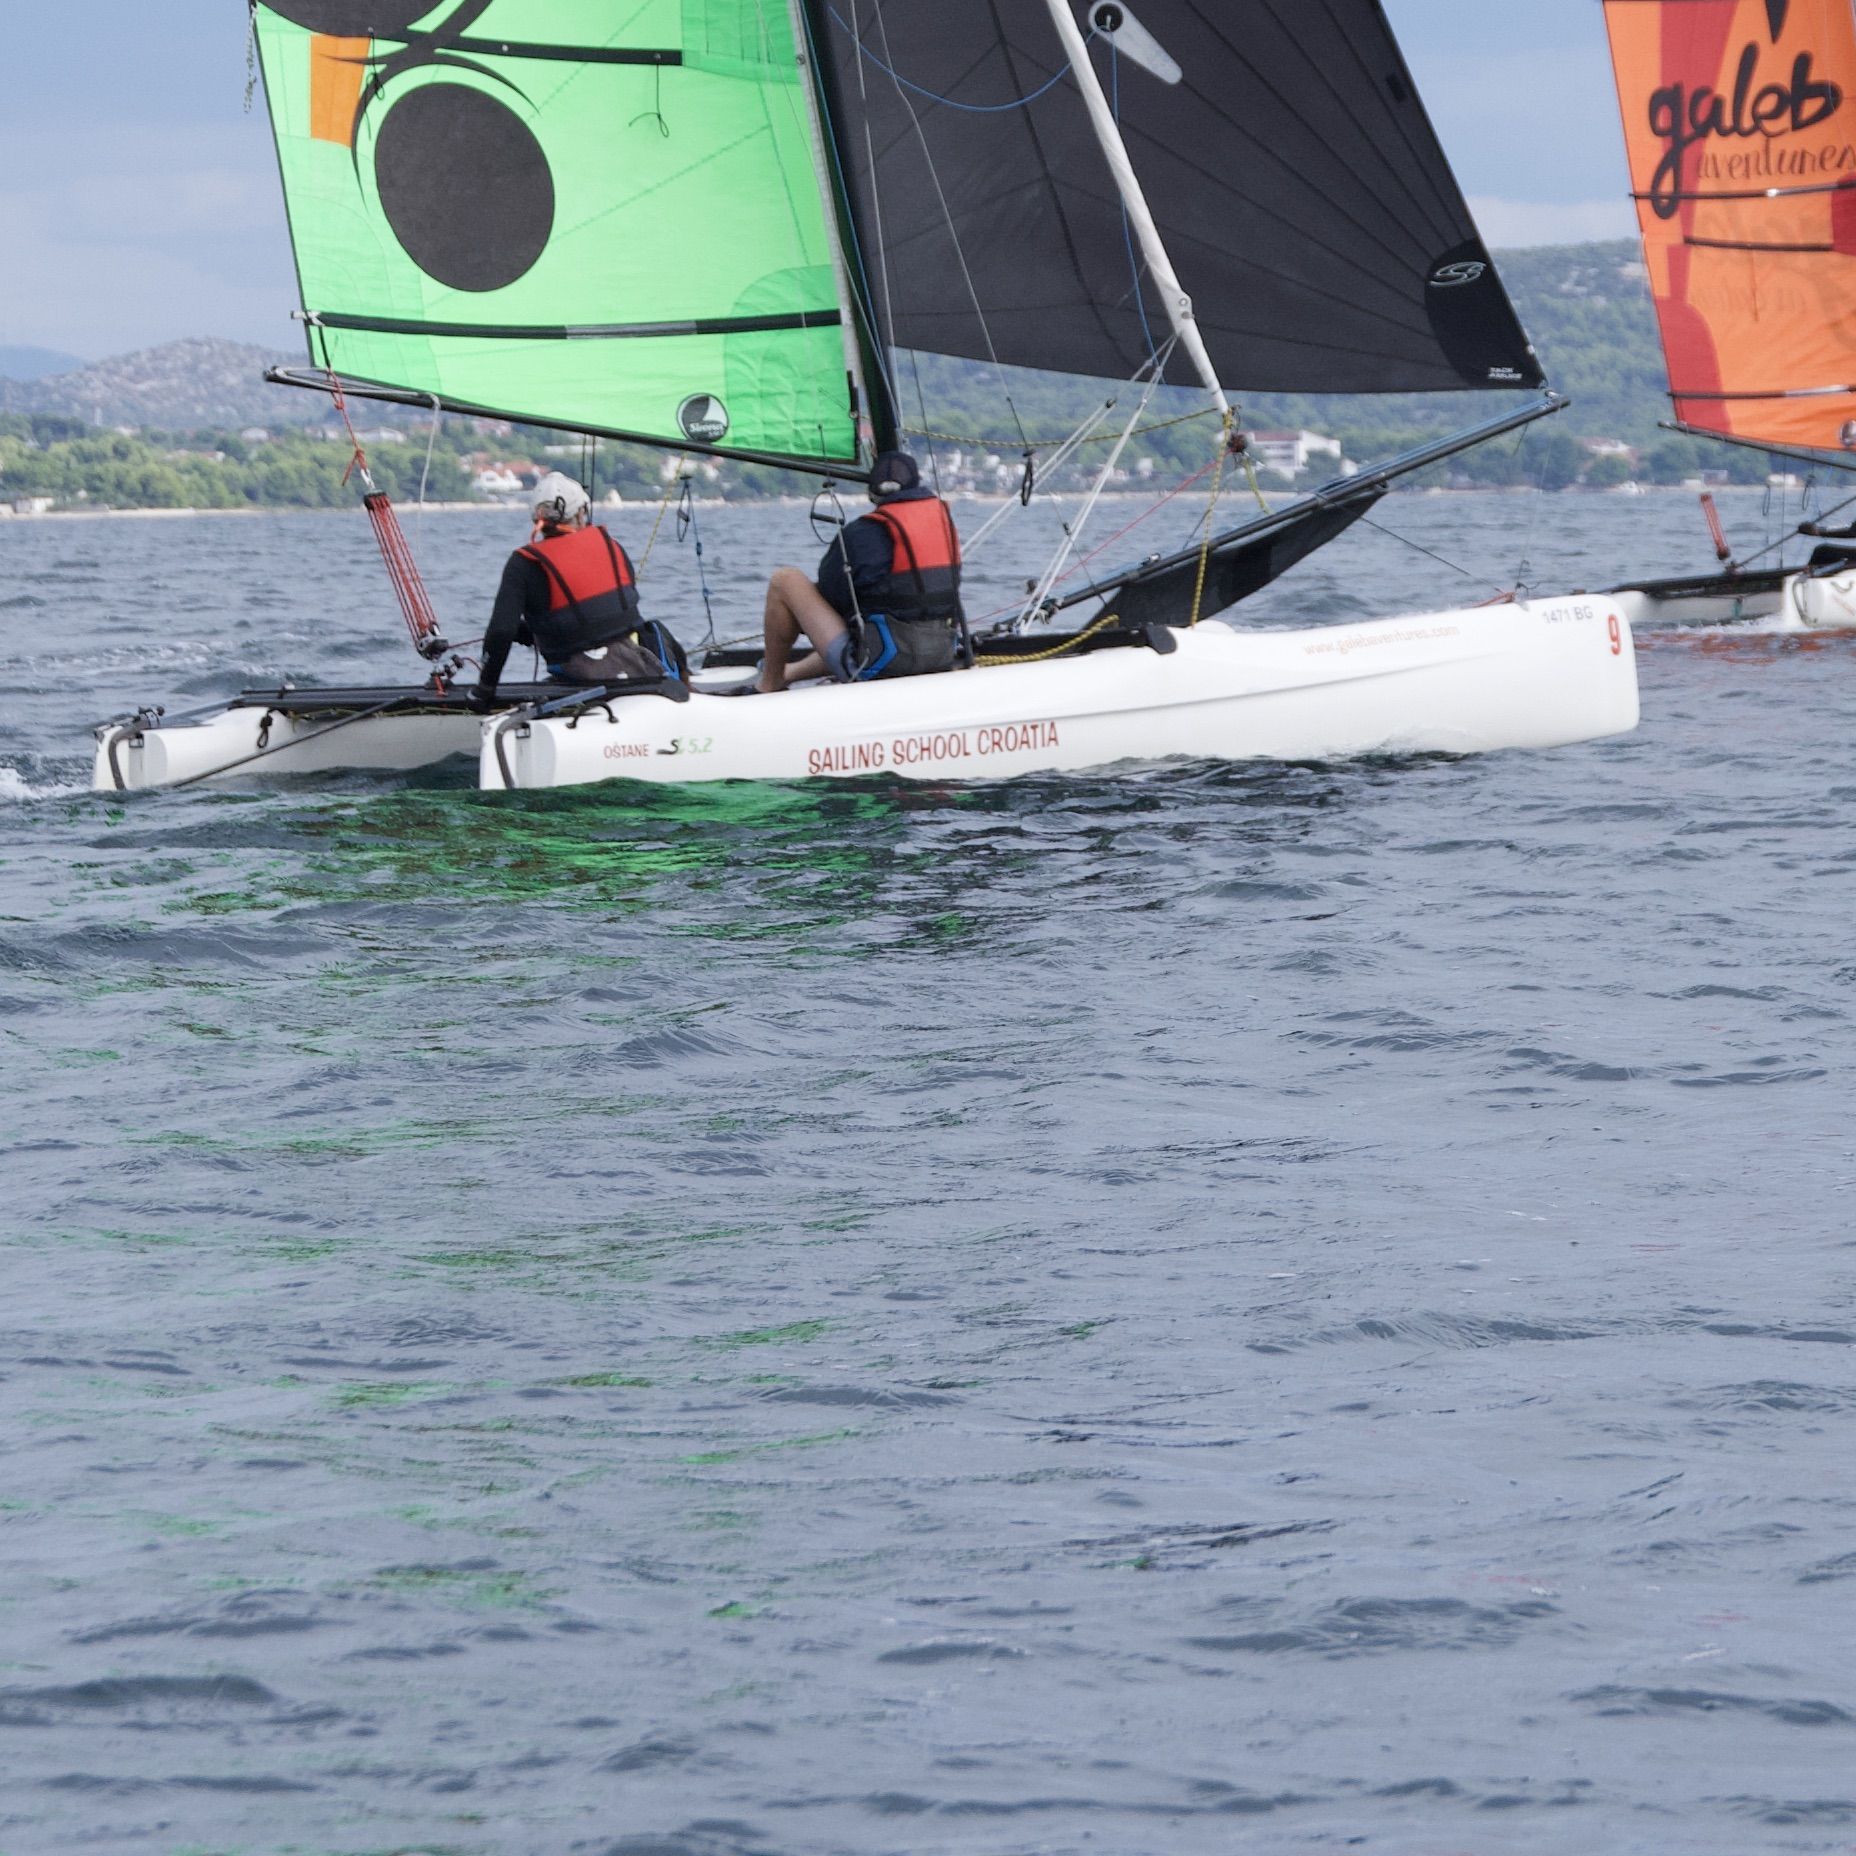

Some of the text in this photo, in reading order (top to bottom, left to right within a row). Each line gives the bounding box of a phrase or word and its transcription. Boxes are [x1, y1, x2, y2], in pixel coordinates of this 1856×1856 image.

[1648, 41, 1843, 221] galeb
[1697, 142, 1856, 182] aventures
[1608, 614, 1621, 656] 9
[688, 737, 713, 754] 5.2
[808, 720, 1060, 775] SAILING SCHOOL CROATIA
